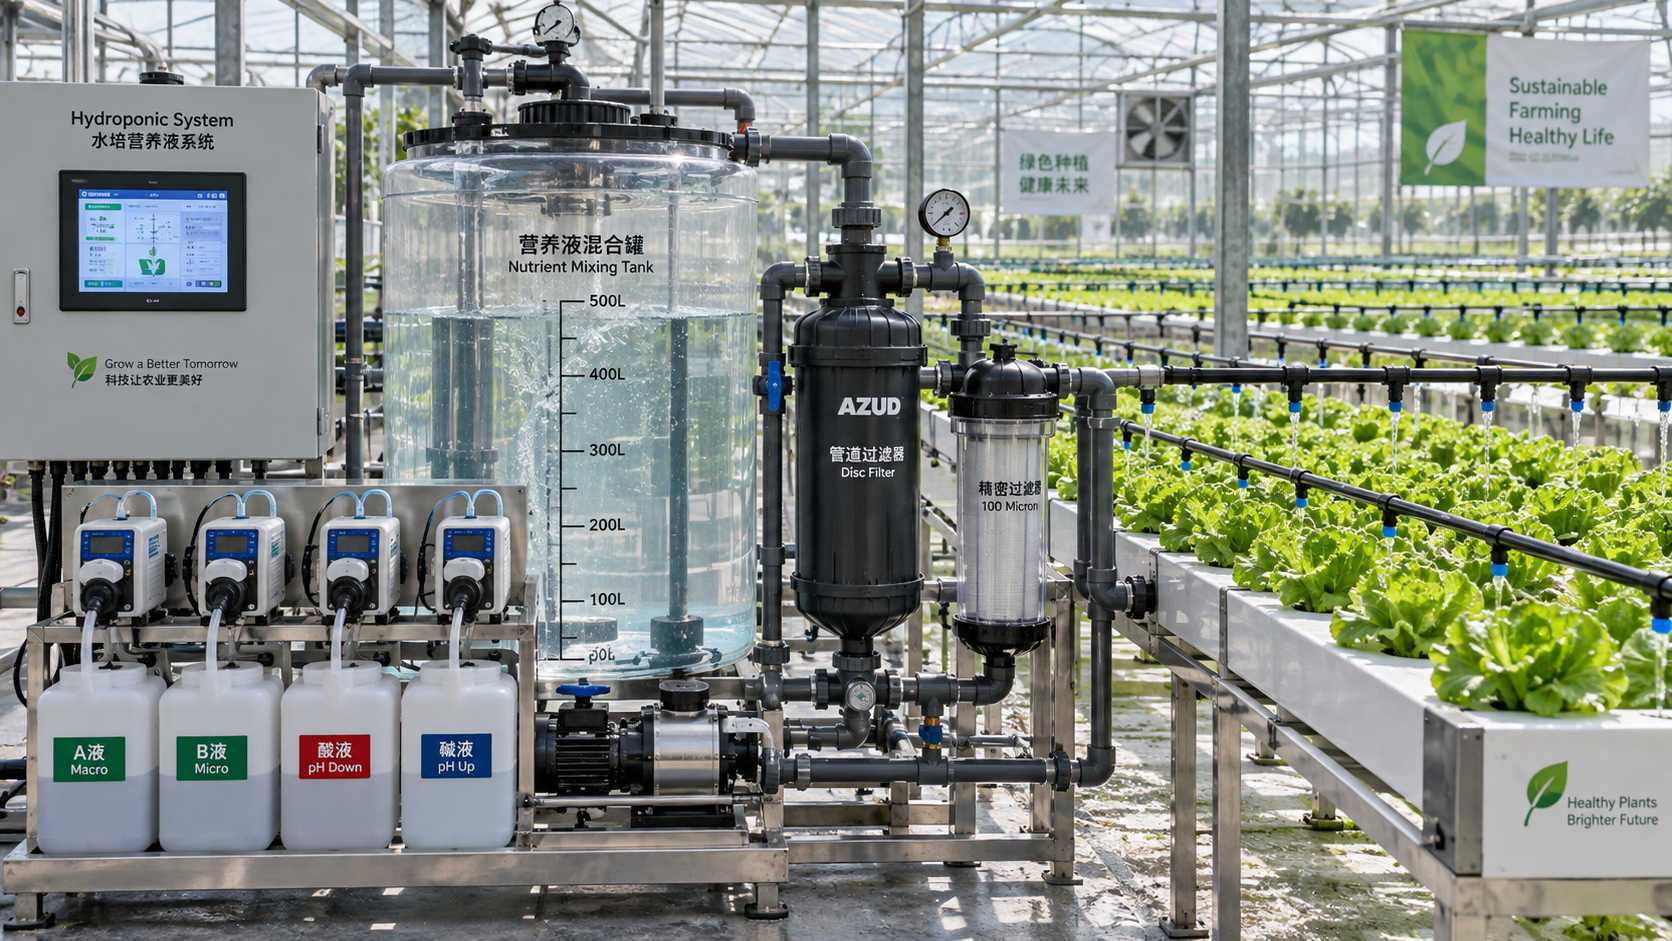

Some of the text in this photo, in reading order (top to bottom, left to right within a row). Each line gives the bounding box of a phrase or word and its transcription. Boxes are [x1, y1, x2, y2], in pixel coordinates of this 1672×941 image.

[1509, 76, 1608, 96] Sustainable
[71, 110, 234, 130] Hydroponic System
[1509, 101, 1581, 124] Farming
[91, 131, 215, 151] 水培营养液系统
[1509, 127, 1615, 149] Healthy Life
[1019, 153, 1089, 172] 绿色种植
[1019, 176, 1089, 195] 健康未来
[518, 233, 645, 256] 营养液混合罐
[508, 259, 654, 277] Nutrient Mixing Tank
[589, 294, 626, 308] 500L
[104, 358, 239, 370] Grow a Better Tomorrow
[105, 373, 203, 387] 科技让农业更美好
[589, 367, 626, 381] 400L
[837, 396, 901, 416] AZUD
[589, 443, 626, 457] 300L
[829, 445, 905, 463] 管道过滤器
[841, 466, 896, 478] Disc Filter
[982, 500, 1039, 512] 100 Micron
[589, 517, 626, 532] 200L
[589, 592, 626, 606] 100L
[73, 743, 105, 761] A液
[196, 742, 227, 760] B液
[317, 741, 352, 759] 酸液
[70, 764, 109, 776] Macro
[194, 762, 229, 775] Micro
[308, 761, 363, 776] pH Down
[438, 760, 475, 775] pH Up
[1567, 795, 1658, 812] Healthy Plants
[1567, 813, 1659, 829] Brighter Future
